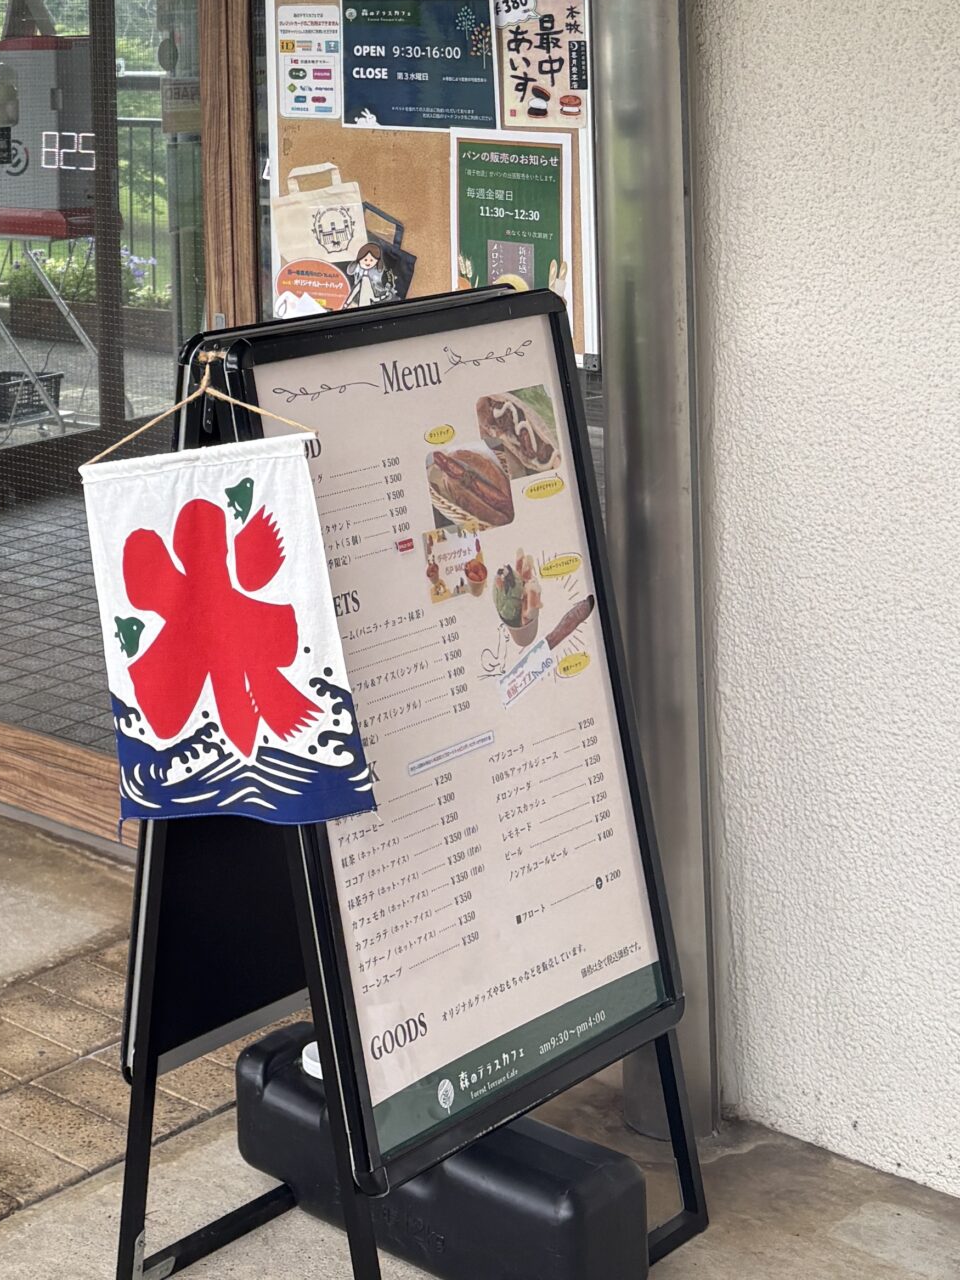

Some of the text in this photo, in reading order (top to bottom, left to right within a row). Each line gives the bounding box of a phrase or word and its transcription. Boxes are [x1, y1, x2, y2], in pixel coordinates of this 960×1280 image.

[565, 5, 583, 34] 本牧
[353, 45, 461, 59] OPEN 9:30-16:00
[533, 14, 565, 87] 最中
[507, 24, 537, 103] あいす
[352, 67, 429, 81] CLOSE 第3水曜日
[461, 150, 559, 167] パンの販売のお知らせ
[466, 187, 513, 201] 毎週金曜日
[379, 357, 443, 395] Menu
[384, 473, 402, 485] ¥500
[386, 489, 405, 501] ¥500
[389, 505, 408, 518] ¥500
[392, 521, 410, 534] ¥400
[439, 615, 457, 628] ¥300
[444, 648, 462, 662] ¥500
[450, 683, 468, 697] ¥500
[452, 700, 471, 714] ¥350
[578, 718, 595, 730] ¥250
[581, 736, 598, 749] ¥250
[434, 772, 452, 787] ¥250
[496, 754, 601, 803] メロンソーダ ¥250
[498, 772, 604, 822] レモンスカッシュ ¥250
[338, 792, 455, 848] アイスコーヒー ¥300
[440, 811, 459, 826] ¥250
[502, 790, 607, 842] レモネード ¥250
[504, 809, 611, 861] ビール ¥500
[345, 873, 365, 889] ココア
[443, 831, 462, 846] ¥350
[447, 851, 466, 866] ¥350
[509, 827, 614, 882] ノンアルコールビール ¥400
[604, 869, 622, 883] ¥200
[351, 908, 386, 931] カフェモカ
[450, 871, 469, 885] ¥350
[355, 929, 389, 952] カフェラテ
[454, 890, 472, 906] ¥350
[358, 949, 391, 973] カプチーノ
[457, 910, 476, 926] ¥350
[362, 931, 480, 994] コーンスープ ¥350
[370, 1012, 428, 1060] GOODS
[458, 1047, 525, 1092] 森のテラスカフェ
